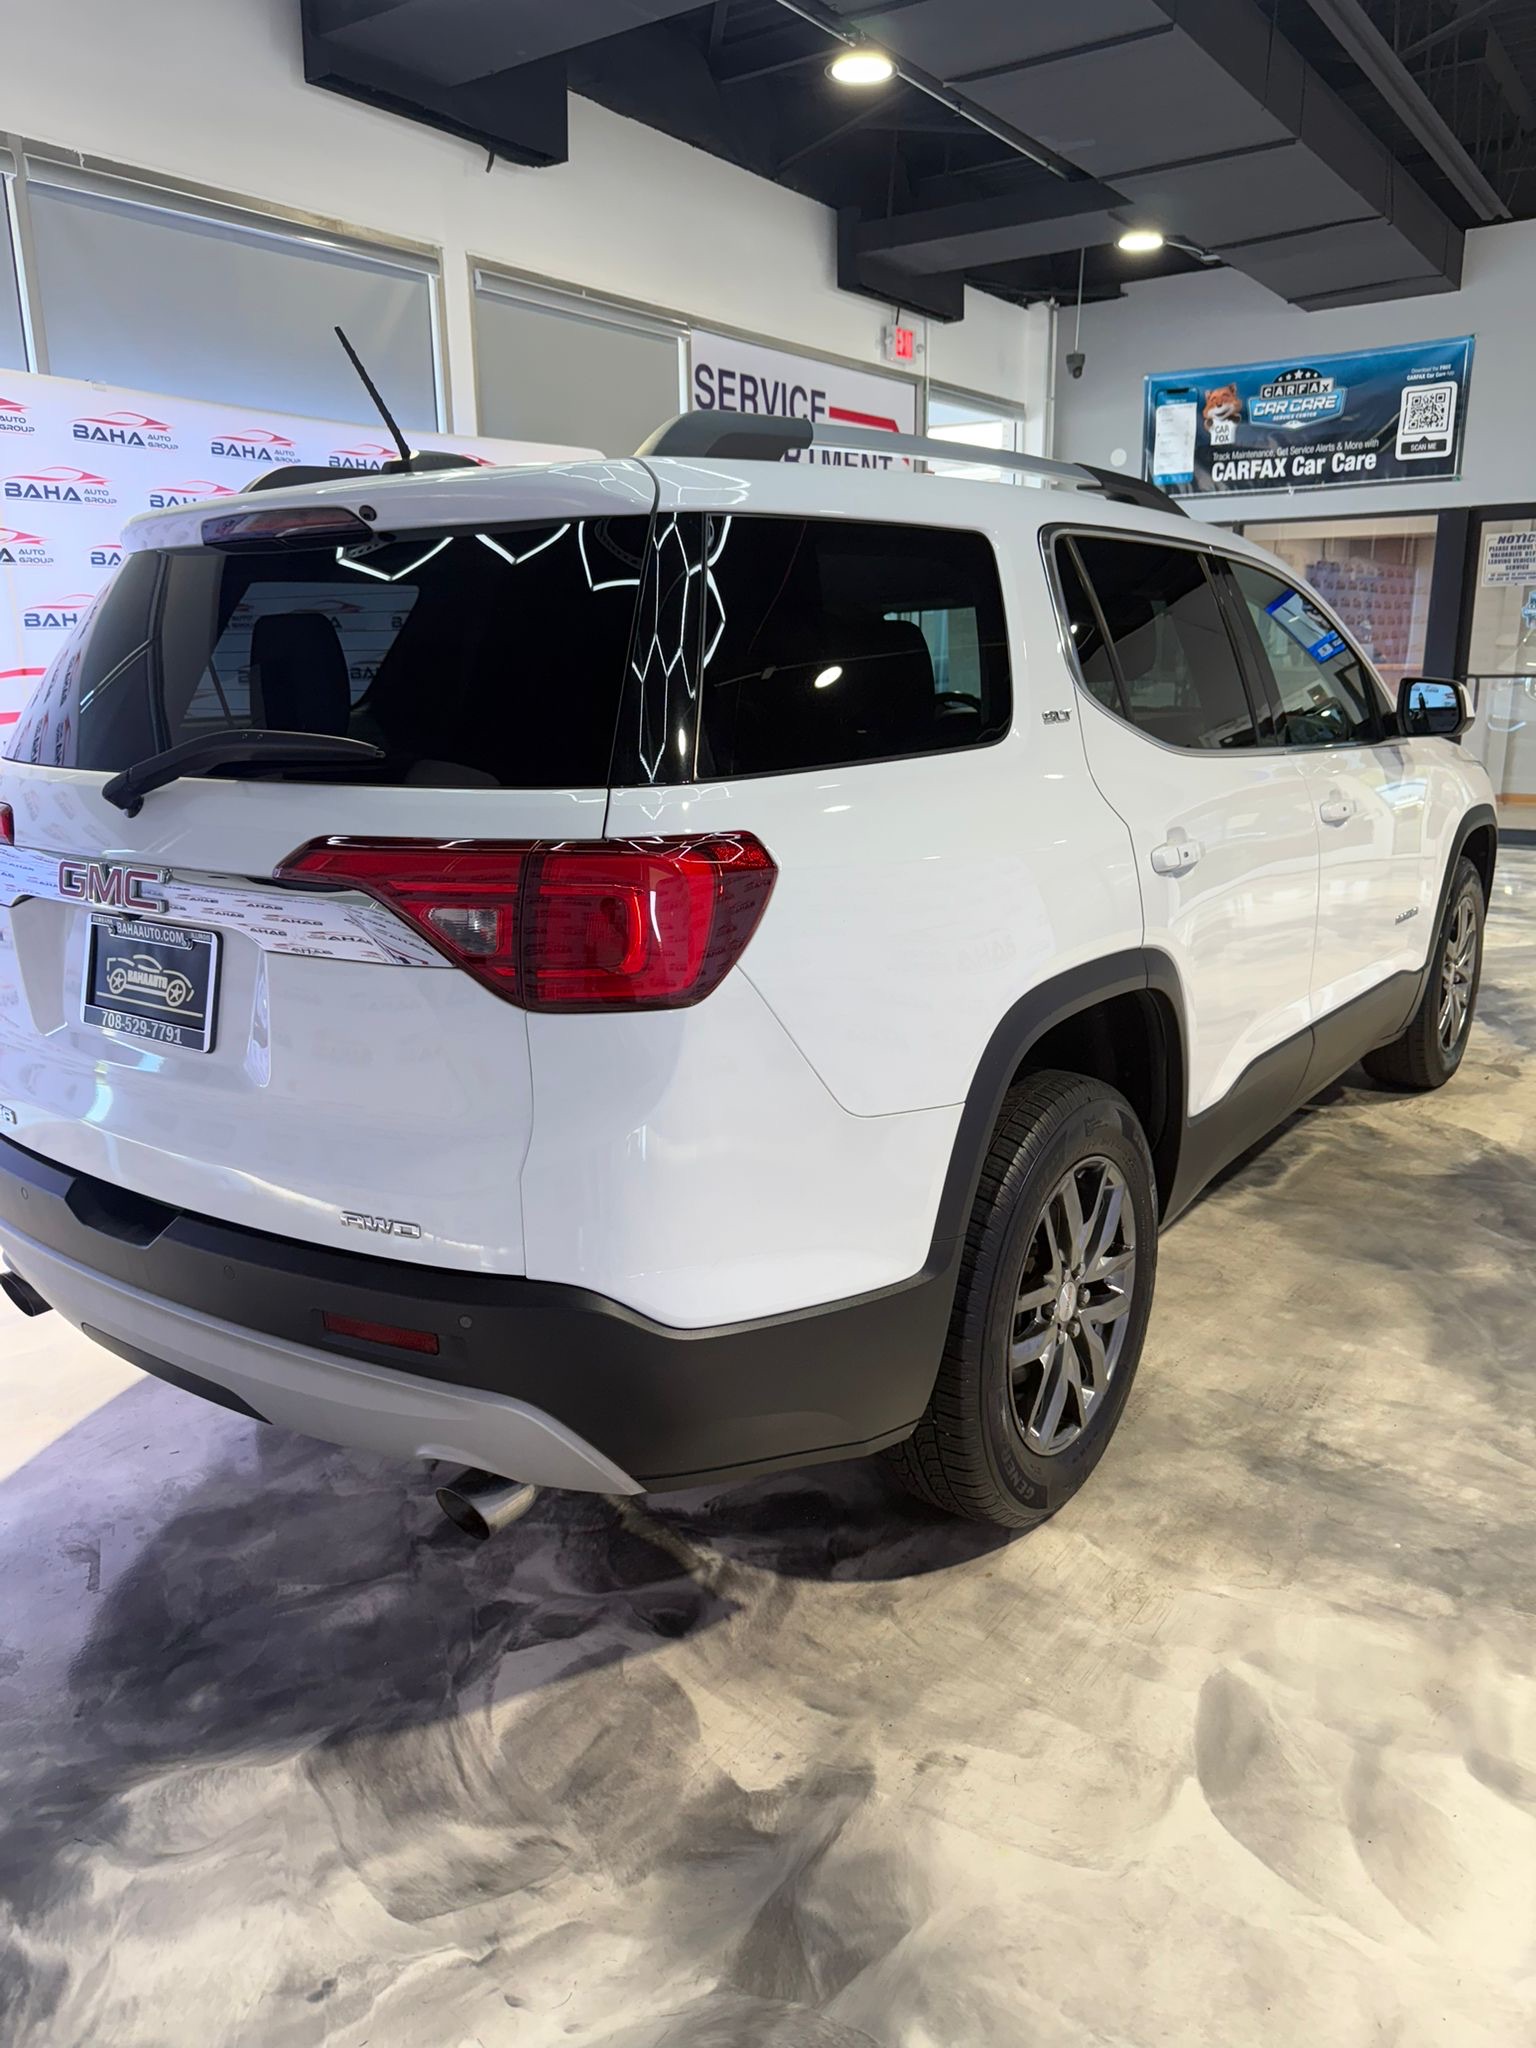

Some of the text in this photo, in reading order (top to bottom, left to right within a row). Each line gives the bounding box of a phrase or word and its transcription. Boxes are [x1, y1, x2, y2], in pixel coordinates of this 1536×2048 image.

[1406, 373, 1426, 381] CARFAX
[694, 363, 827, 424] SERVICE
[1262, 383, 1330, 398] CARFAX
[1253, 395, 1338, 417] CAR CARE
[72, 423, 145, 447] BAHA
[1214, 424, 1230, 433] CAR
[147, 434, 172, 442] AUTO
[1213, 434, 1230, 443] FOX
[211, 441, 272, 461] BAHA
[274, 449, 295, 457] AUTO
[1213, 452, 1231, 461] Track
[1276, 447, 1289, 456] Get
[1290, 444, 1315, 455] Service
[1315, 442, 1335, 453] Alerts
[1336, 442, 1343, 450] &
[1344, 440, 1363, 450] More
[1364, 439, 1379, 448] with
[1410, 442, 1437, 452] SCAN ME
[274, 456, 301, 464] GROUP
[1211, 453, 1377, 482] CARFAX Car Care
[4, 482, 82, 502] BAHA
[84, 488, 109, 496] AUTO
[84, 497, 117, 505] GROUP
[1497, 533, 1536, 544] NOTIC
[1488, 557, 1511, 565] LEAVING
[24, 613, 78, 627] BAH
[58, 858, 167, 913] GMC
[116, 921, 184, 945] BAHAAUTO.COM
[127, 969, 169, 990] BAHAAUTO
[101, 1010, 183, 1045] 708-529-7791
[340, 1210, 422, 1239] AWD
